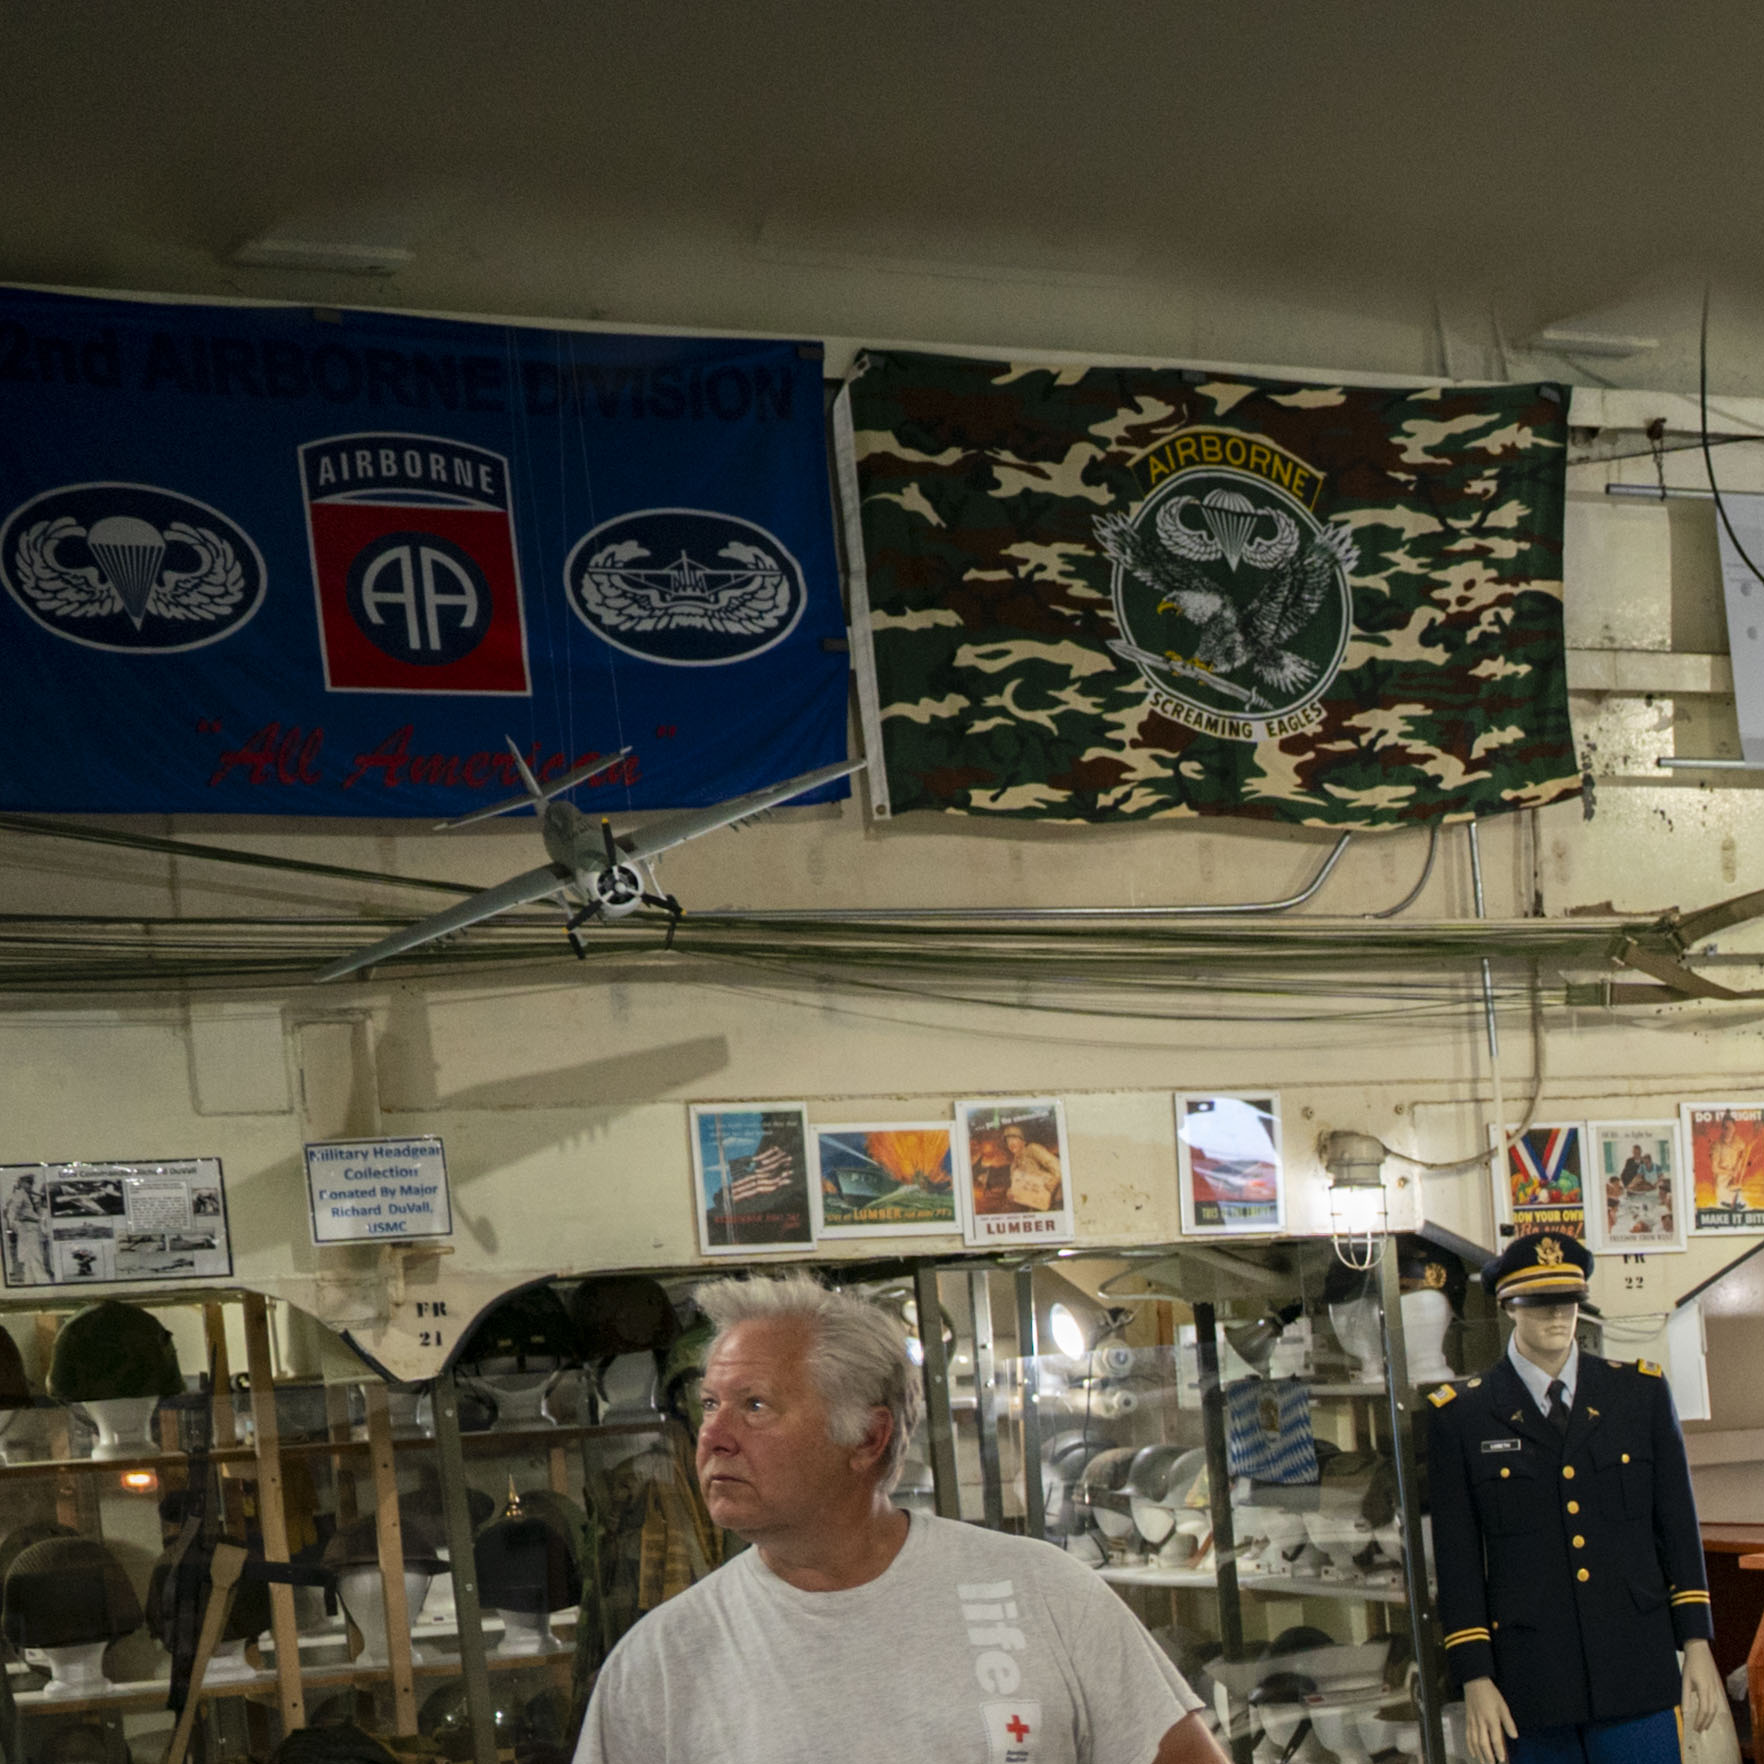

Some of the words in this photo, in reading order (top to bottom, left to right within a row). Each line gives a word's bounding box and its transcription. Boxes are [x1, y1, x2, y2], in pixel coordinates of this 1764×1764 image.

[145, 332, 504, 412] AIRBORNE
[523, 359, 793, 422] DIVISION
[319, 449, 494, 494] AIRBORNE
[1149, 435, 1310, 497] AIRBORNE
[1151, 691, 1253, 738] SCREAMING
[1266, 702, 1322, 738] EAGLES
[1695, 1111, 1712, 1122] DO
[344, 1166, 418, 1180] Collection
[380, 1187, 396, 1198] By
[400, 1184, 438, 1197] Major
[331, 1204, 381, 1217] Richard
[388, 1202, 433, 1214] DuVall,
[854, 1208, 901, 1220] LUMBER
[1513, 1210, 1534, 1224] ROW
[1536, 1210, 1561, 1223] YOUR
[1563, 1208, 1585, 1222] OWN
[1700, 1213, 1730, 1225] MAKE
[1732, 1213, 1743, 1224] IT
[368, 1221, 407, 1233] USMC
[986, 1220, 1055, 1235] LUMBER
[1625, 1277, 1644, 1289] 22
[416, 1302, 447, 1318] FR
[419, 1330, 442, 1347] 21
[957, 1579, 1027, 1697] life
